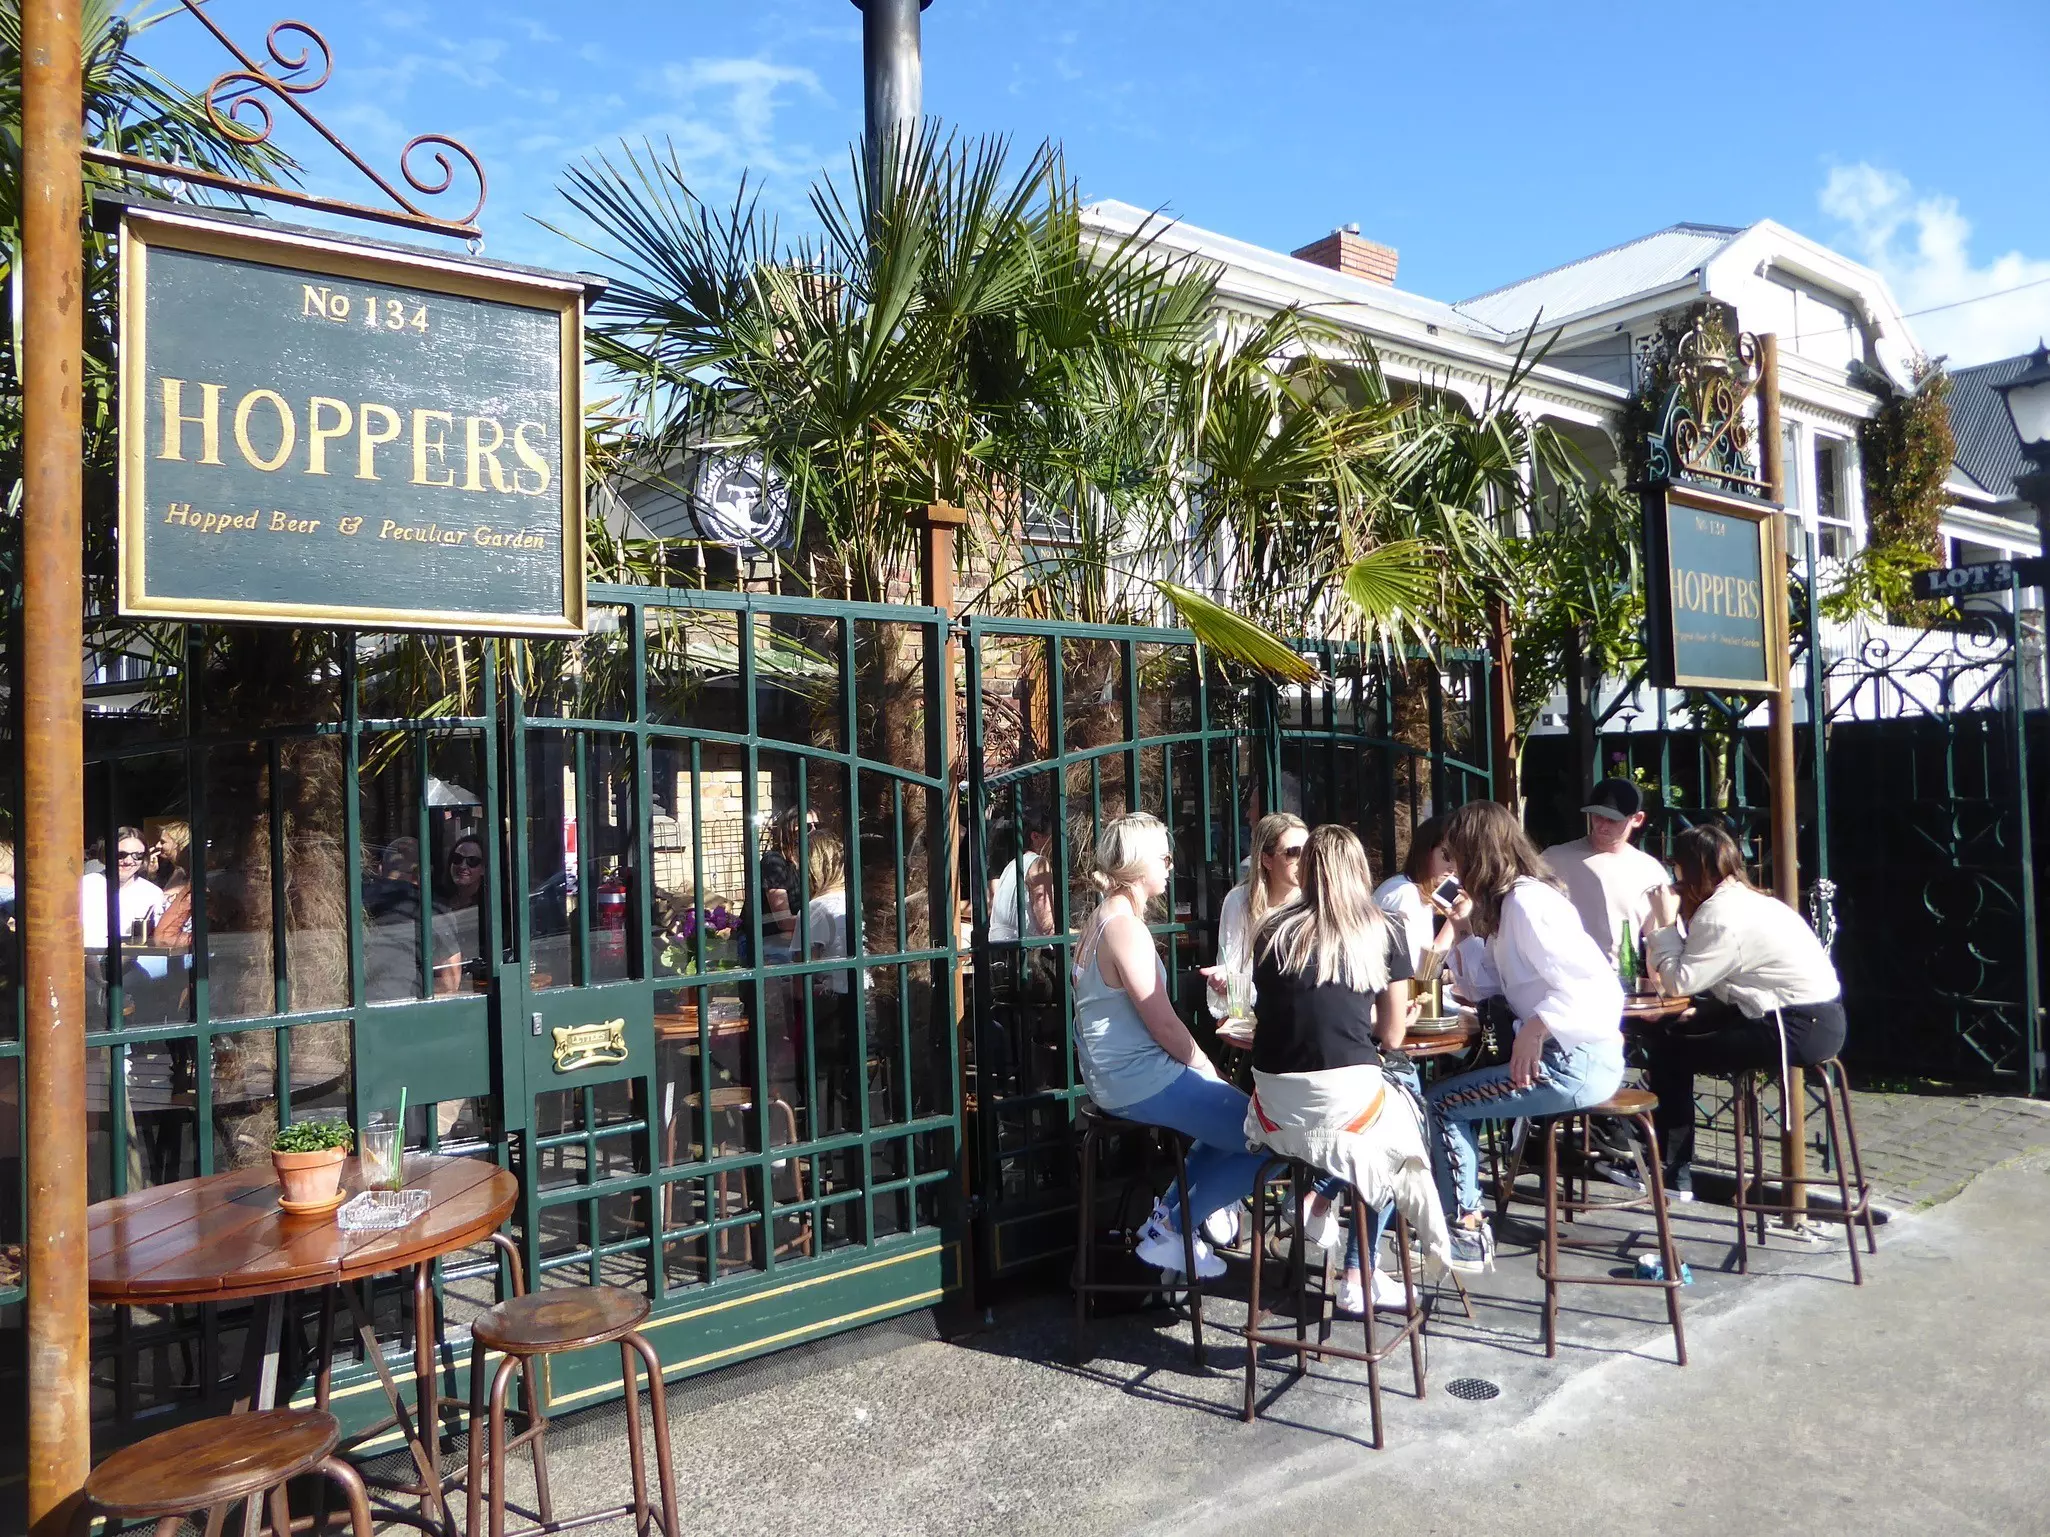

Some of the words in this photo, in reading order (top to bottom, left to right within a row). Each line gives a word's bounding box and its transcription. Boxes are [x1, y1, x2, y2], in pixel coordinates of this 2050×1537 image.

[301, 284, 350, 323] No
[364, 296, 430, 334] 134
[155, 377, 552, 497] HOPPERS
[164, 502, 260, 535] Hopped
[267, 509, 322, 534] Beer
[338, 516, 364, 536] &
[378, 518, 468, 545] Peculiar
[473, 526, 546, 550] Garden
[1670, 567, 1760, 620] HOPPERS
[1928, 566, 1990, 590] LOT
[1994, 562, 2011, 583] 3
